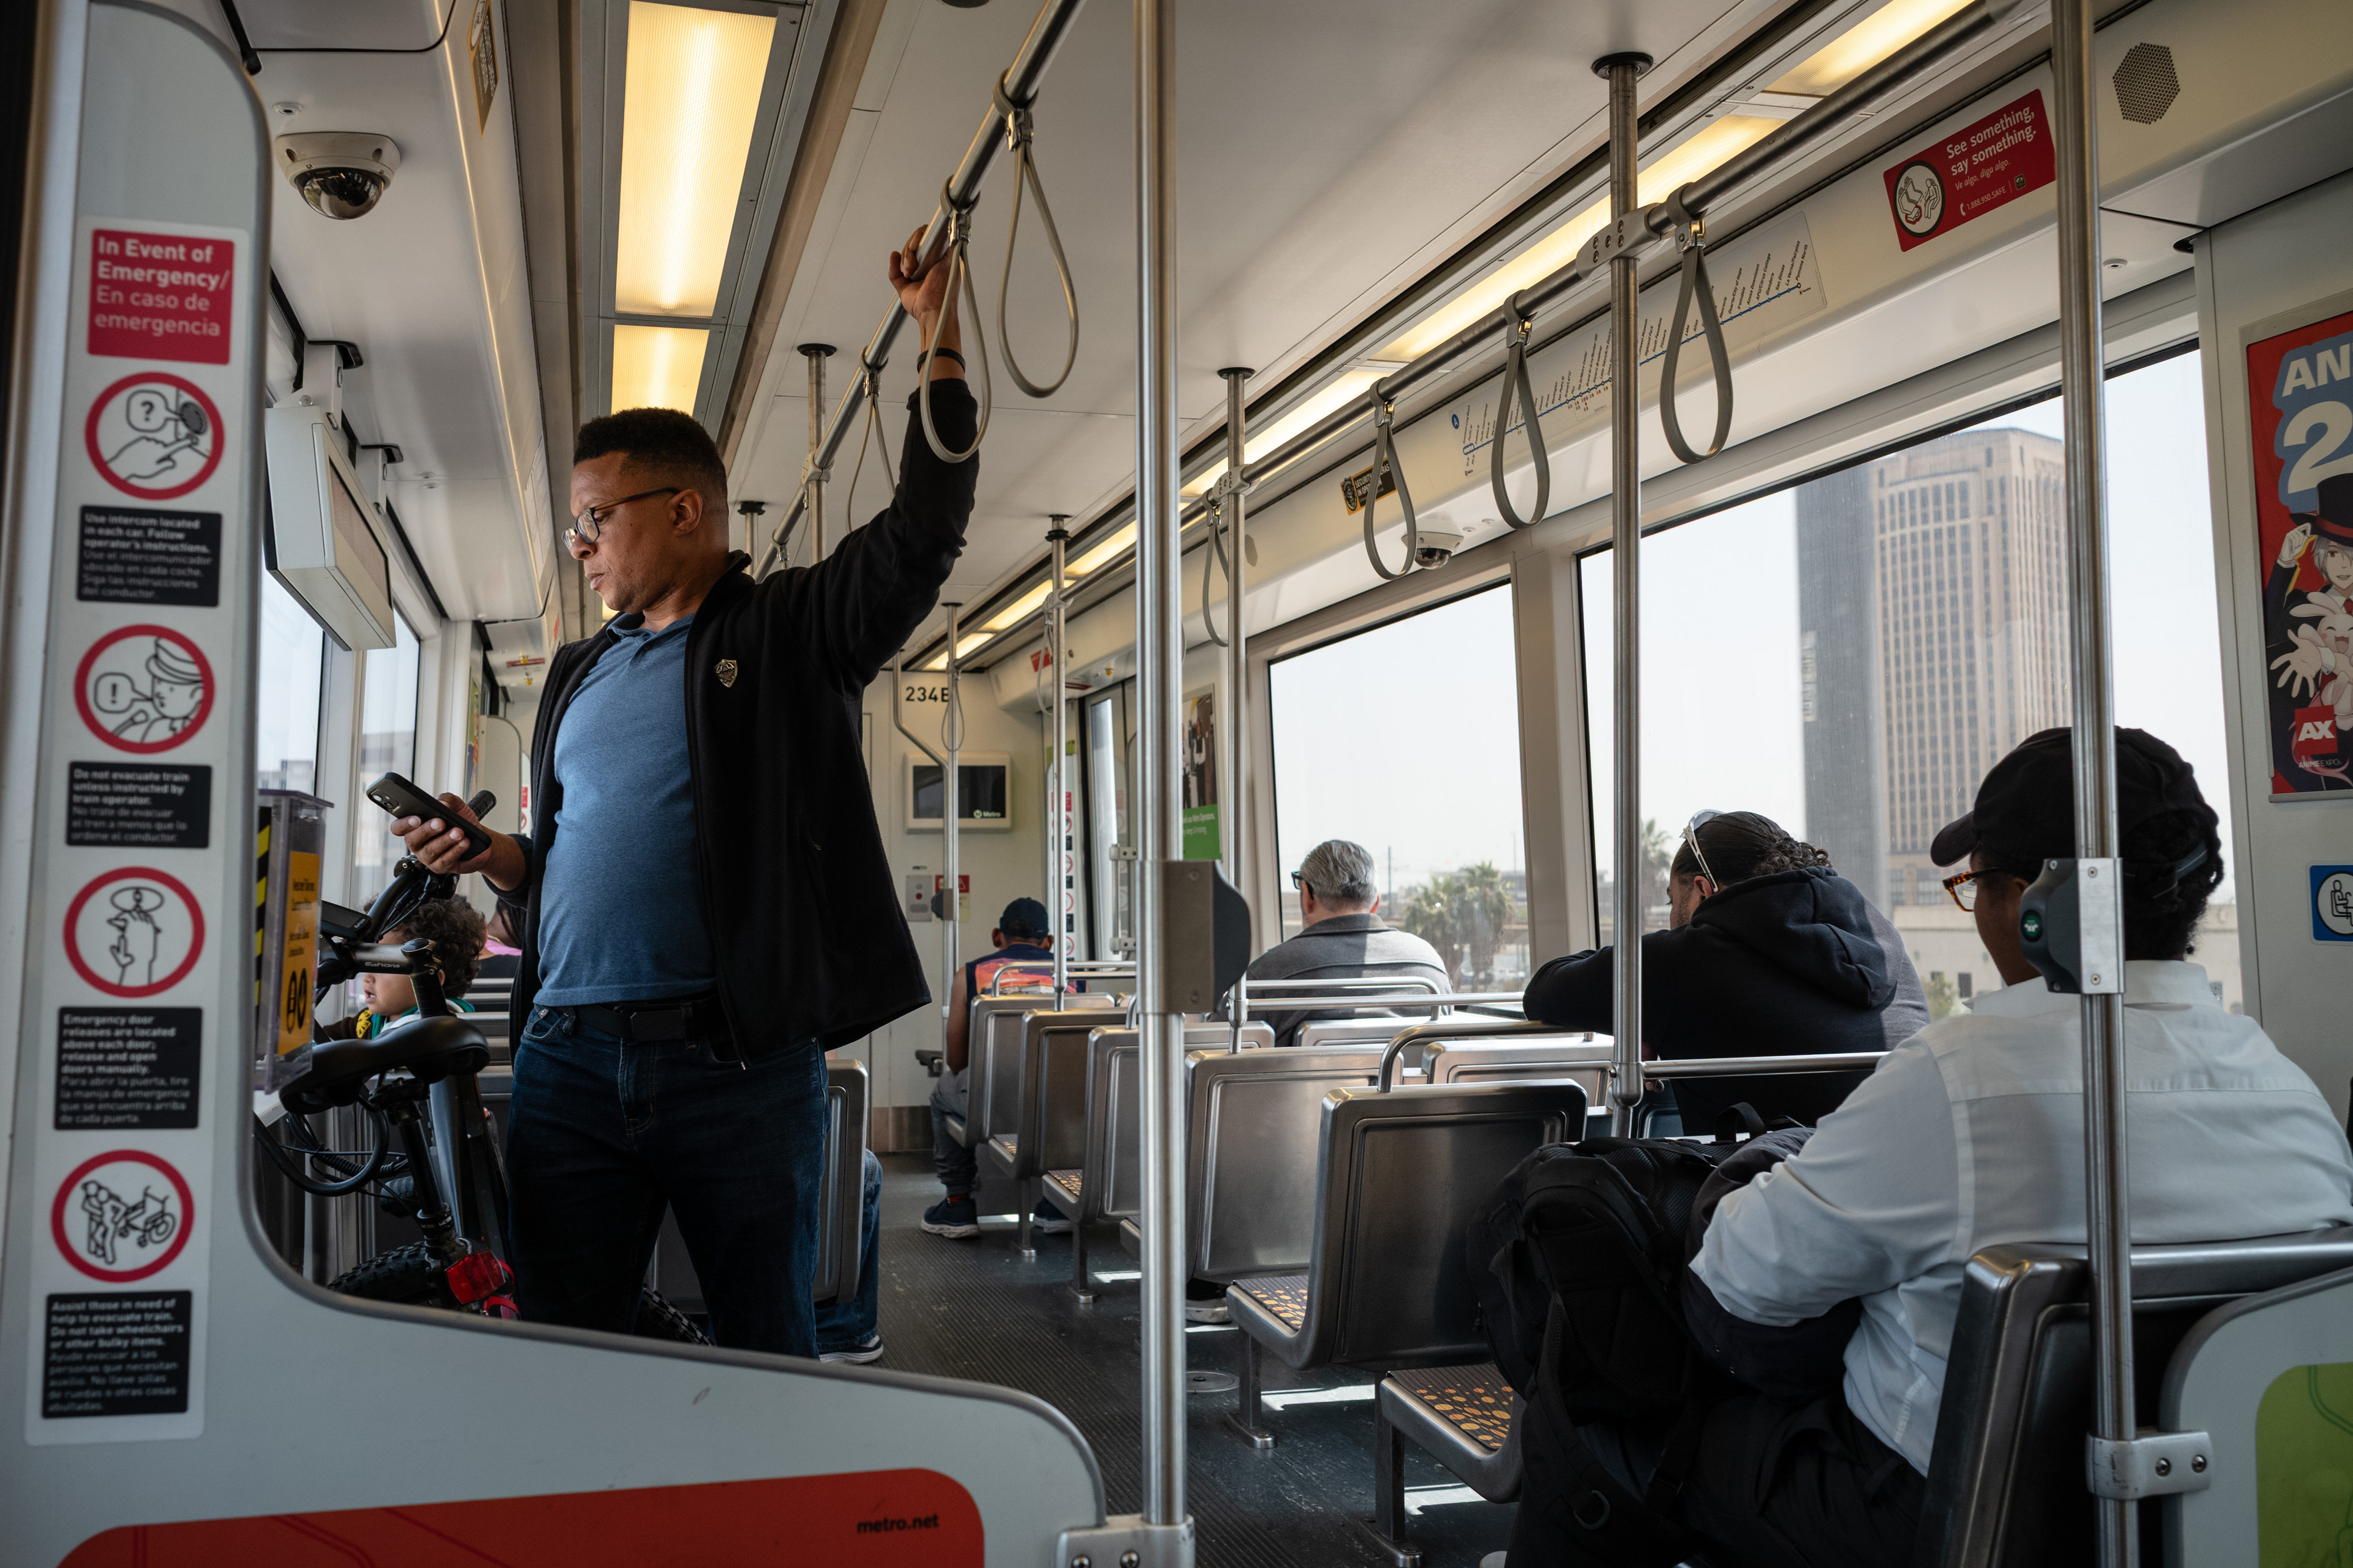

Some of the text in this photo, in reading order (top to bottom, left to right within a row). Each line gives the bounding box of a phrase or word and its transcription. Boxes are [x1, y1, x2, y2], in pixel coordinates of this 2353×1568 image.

[1947, 107, 2034, 159] See something,
[1951, 126, 2036, 176] say something.
[1955, 160, 2010, 190] Ve algo, diga algo.
[1967, 186, 2007, 210] 1.888.950.SAFE
[98, 236, 214, 263] In Event of
[1763, 253, 1771, 272] College
[1795, 261, 1804, 281] Pomona
[97, 259, 230, 292] Emergency/
[1751, 263, 1759, 289] Downtown
[1766, 272, 1774, 295] Glendora
[96, 284, 211, 312] En caso de
[1737, 286, 1745, 309] Irwindale
[95, 313, 221, 337] emergencia
[2298, 720, 2335, 742] AX
[2298, 759, 2339, 769] ANIME EXPO
[857, 1513, 939, 1534] metro.net
